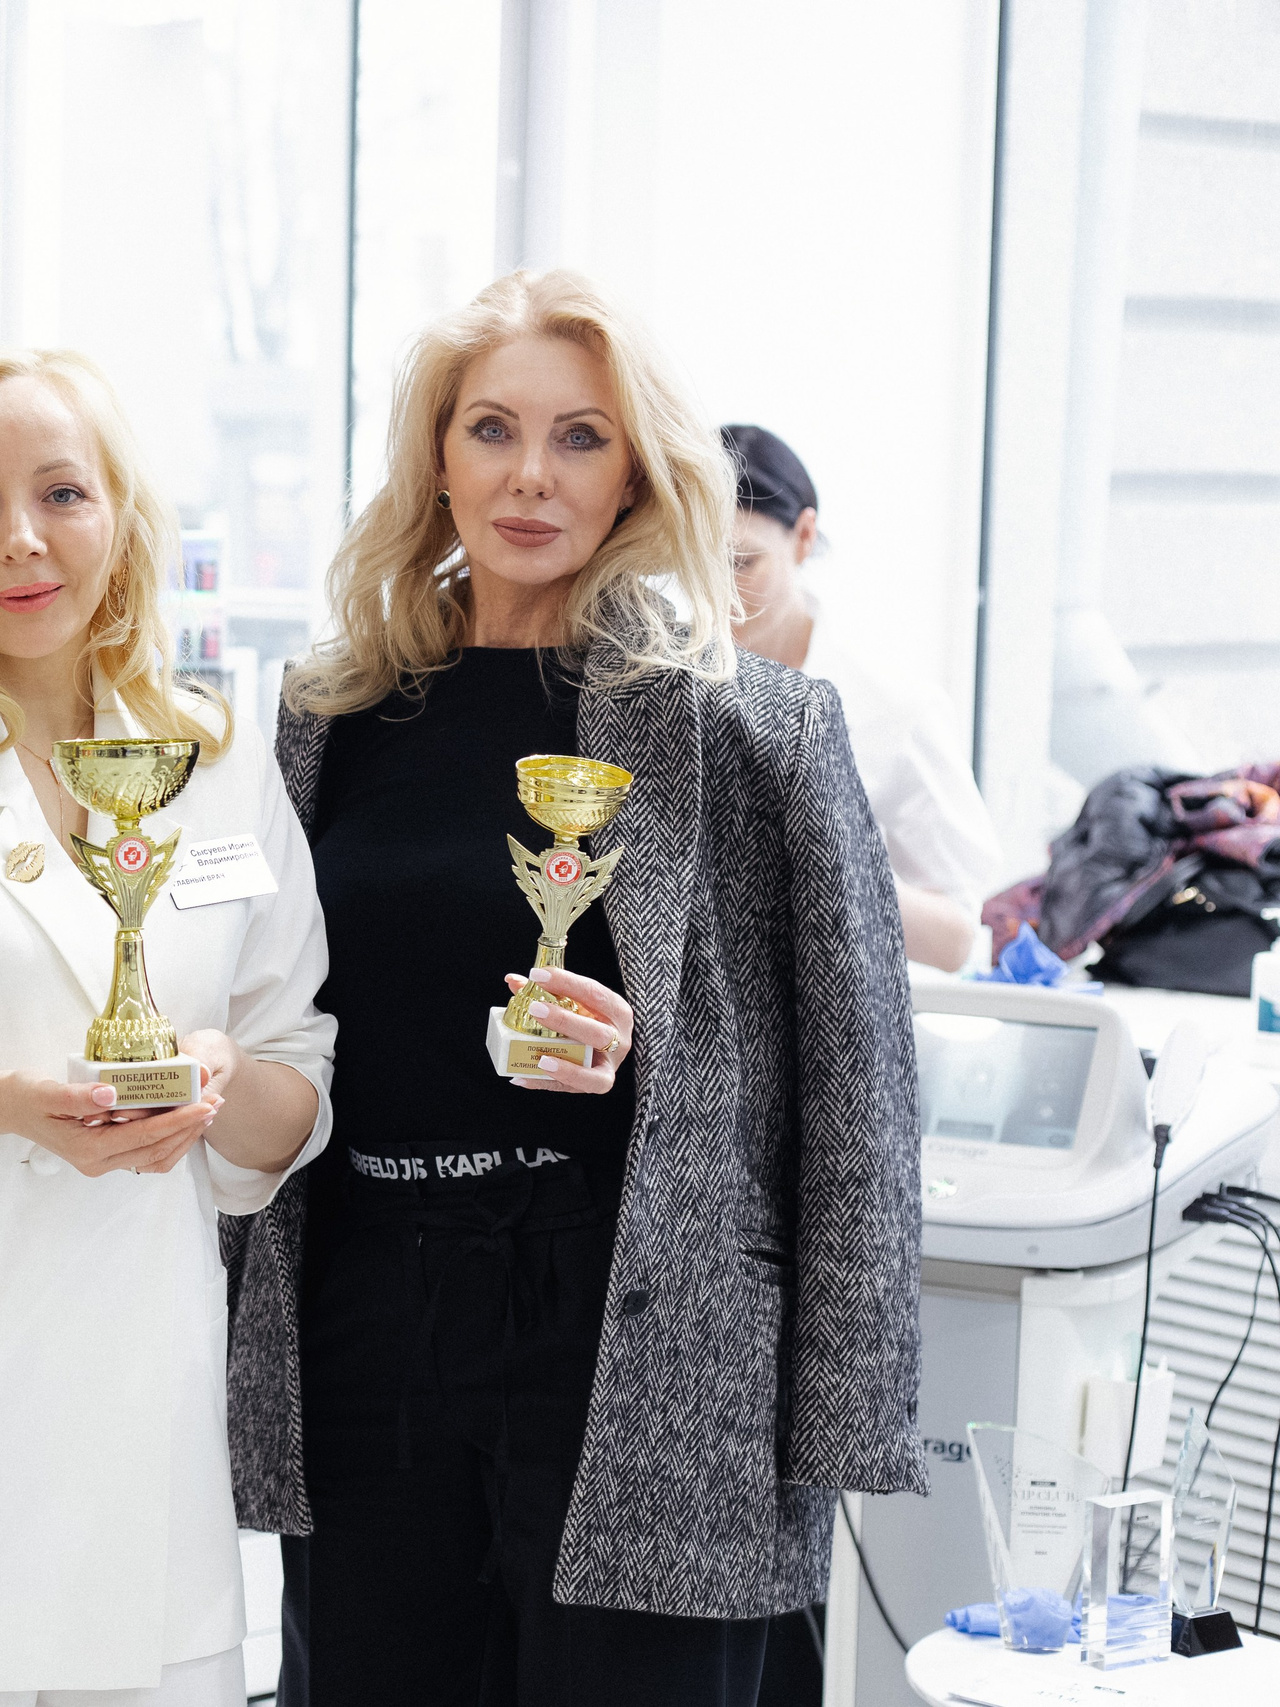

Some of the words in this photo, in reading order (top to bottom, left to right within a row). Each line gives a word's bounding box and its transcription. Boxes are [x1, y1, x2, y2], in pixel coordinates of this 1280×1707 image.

[190, 846, 227, 857] Сысуева
[228, 841, 255, 851] Ирина
[528, 1046, 568, 1054] ПОБЕДИТЕЛЬ
[112, 1072, 180, 1083] ПОБЕДИТЕЛЬ
